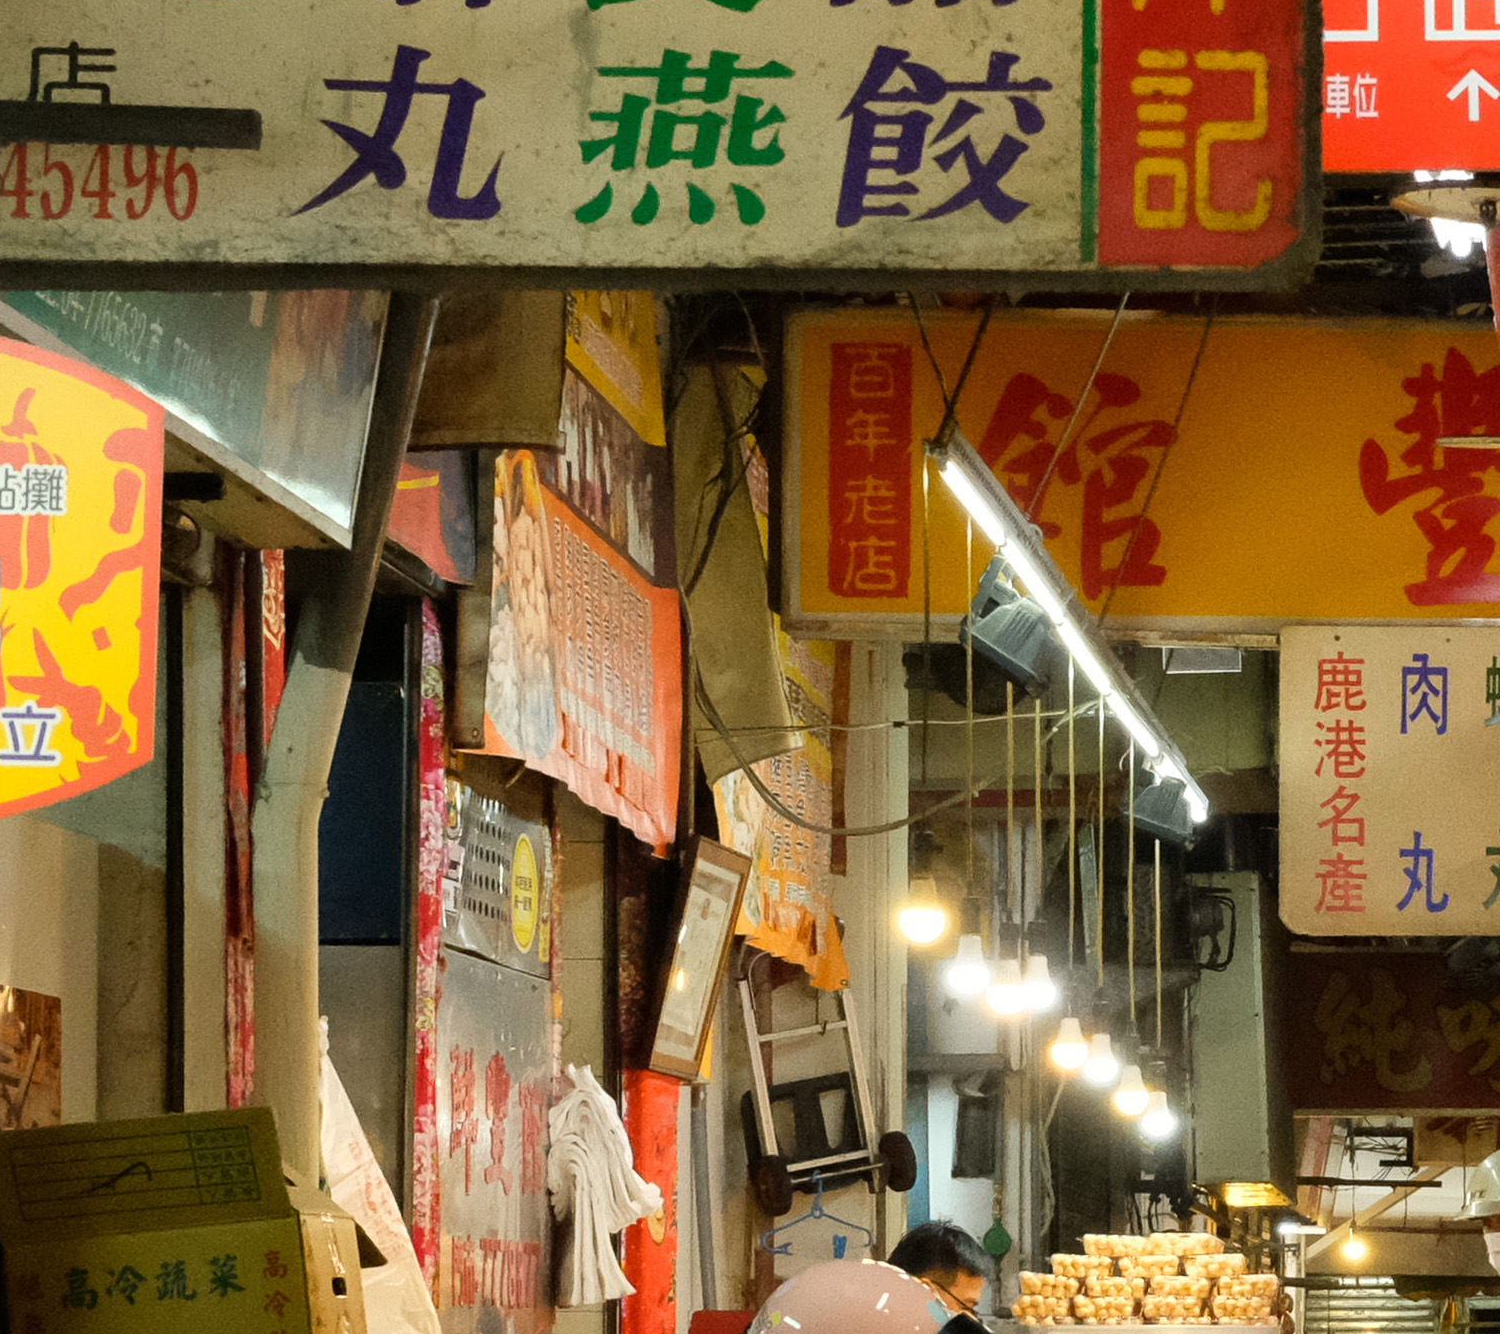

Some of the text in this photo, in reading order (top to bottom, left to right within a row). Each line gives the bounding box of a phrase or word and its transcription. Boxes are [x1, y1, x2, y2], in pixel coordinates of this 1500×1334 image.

[840, 346, 902, 594] 百年老店
[1313, 651, 1368, 915] 鹿港名產
[1397, 651, 1451, 915] 肉丸
[62, 1253, 247, 1311] 高冷蔬菜
